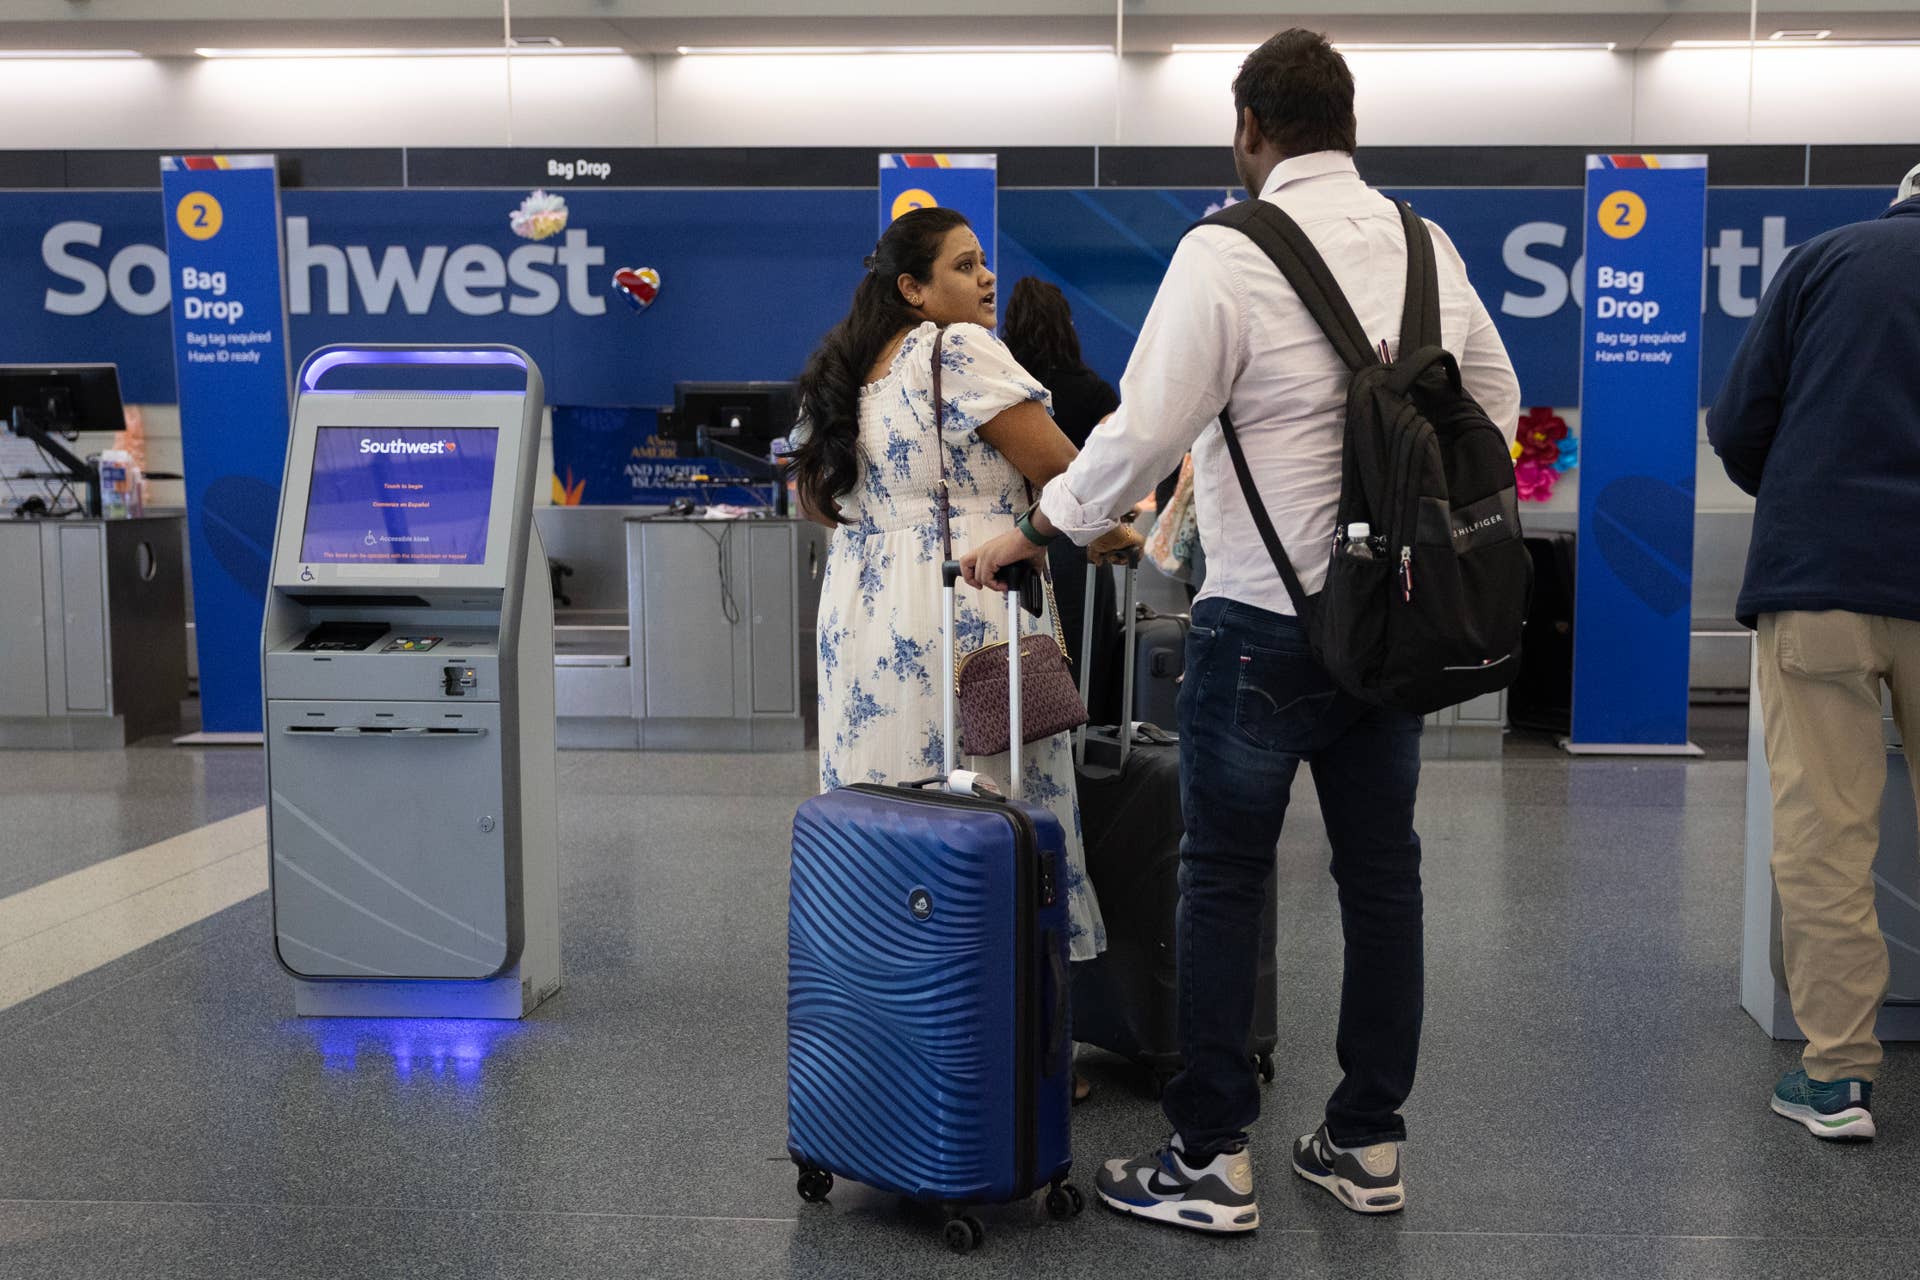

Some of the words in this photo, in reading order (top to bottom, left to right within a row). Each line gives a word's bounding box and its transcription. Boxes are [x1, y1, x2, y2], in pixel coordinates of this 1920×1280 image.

[547, 159, 574, 180] Bag
[576, 159, 611, 180] Drop
[192, 204, 208, 227] 2
[1614, 203, 1630, 226] 2
[42, 216, 606, 315] Sohwest
[182, 266, 227, 296] Bag
[1597, 266, 1644, 295] Bag
[184, 296, 244, 325] Drop
[1597, 296, 1660, 324] Drop
[186, 332, 208, 347] Bag
[209, 333, 226, 347] tag
[227, 331, 272, 346] required
[1596, 332, 1618, 346] Bag
[1619, 332, 1638, 346] tag
[1639, 331, 1687, 346] required
[187, 350, 215, 363] Have
[216, 350, 229, 362] ID
[231, 350, 261, 365] ready
[1595, 350, 1625, 362] Have
[1625, 350, 1639, 362] ID
[1640, 350, 1673, 365] ready
[360, 438, 445, 454] Southwest
[624, 464, 652, 475] AND
[1458, 513, 1502, 537] HILFIGER
